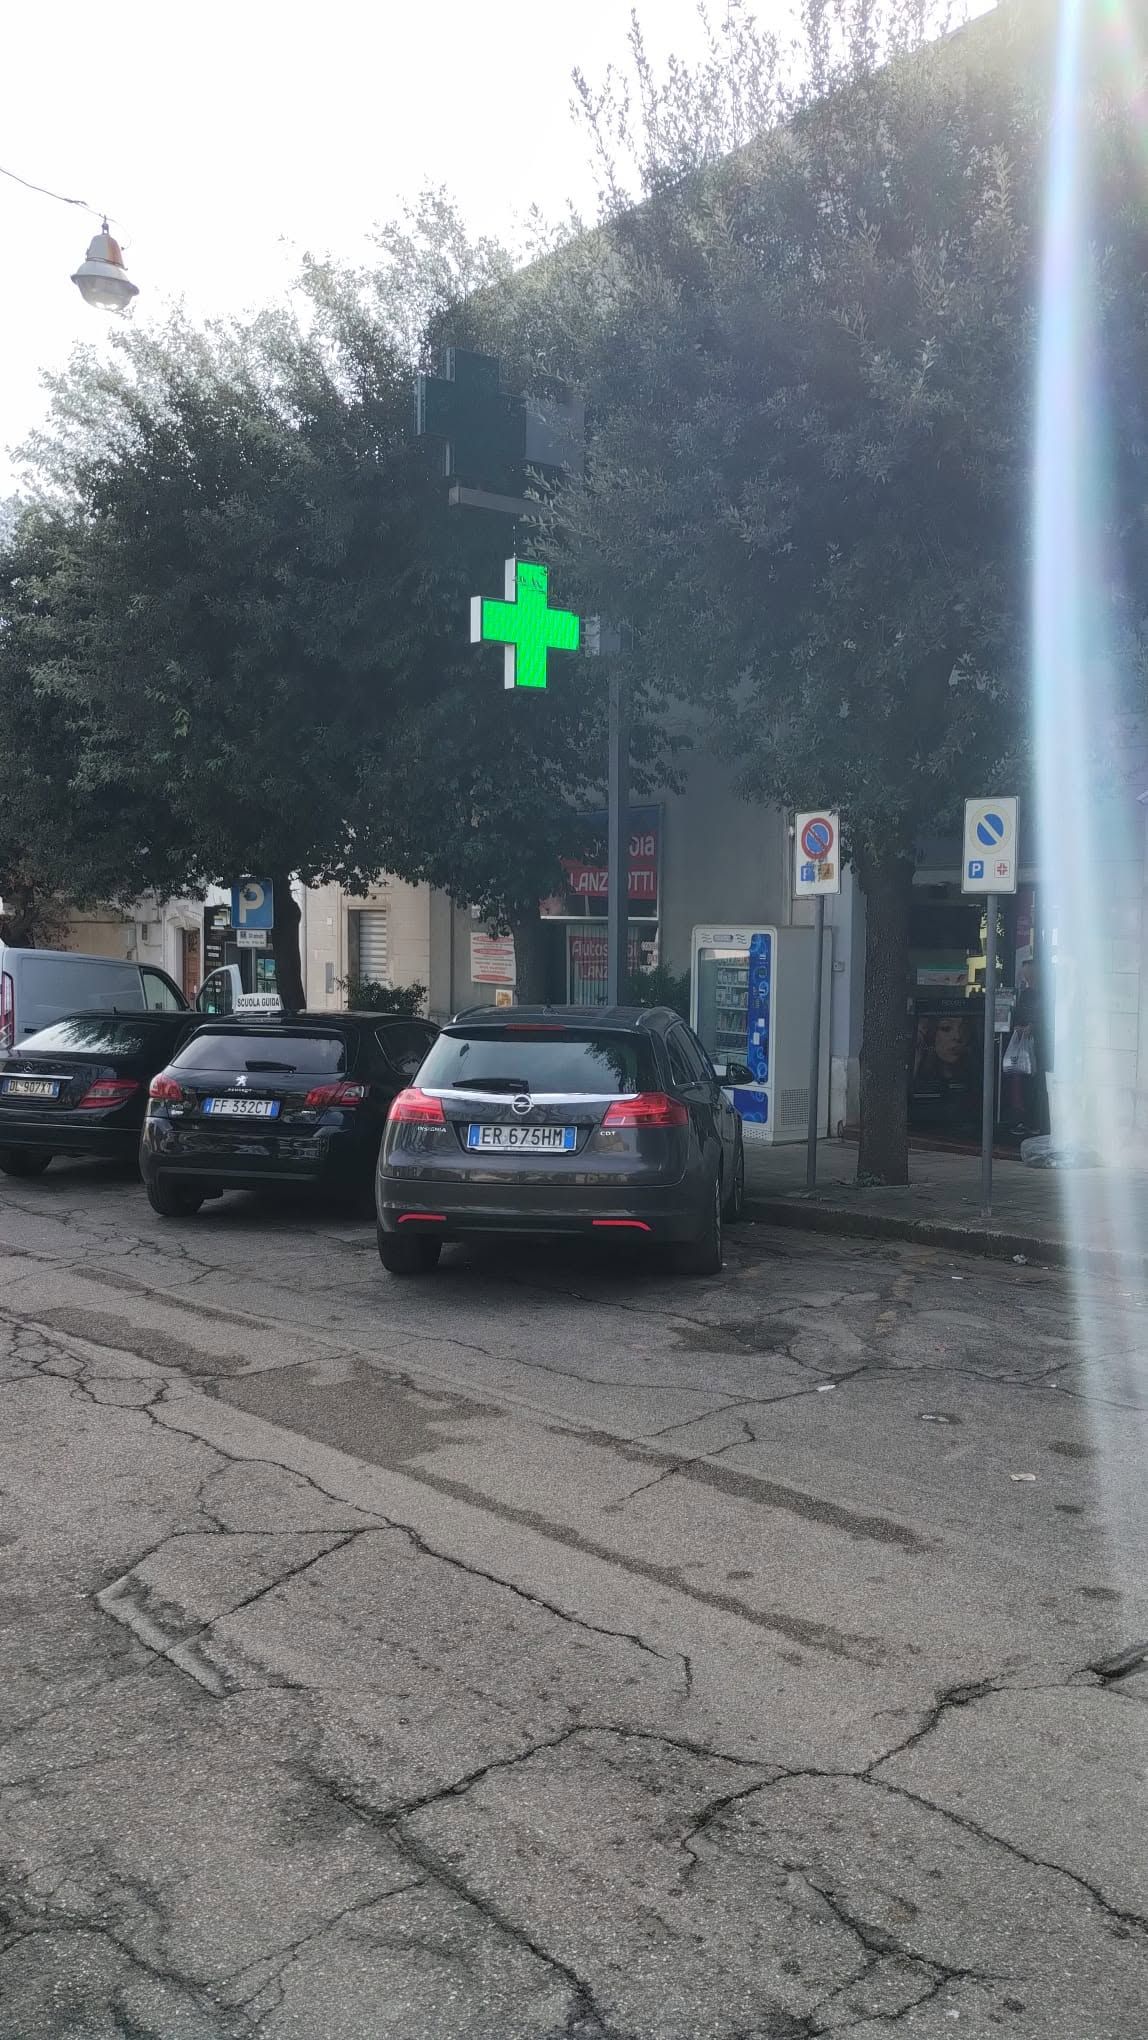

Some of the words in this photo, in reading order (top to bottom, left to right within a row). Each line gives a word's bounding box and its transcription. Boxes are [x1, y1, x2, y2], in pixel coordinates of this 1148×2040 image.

[972, 863, 982, 877] P
[239, 883, 265, 923] P
[237, 998, 260, 1007] SCUOLA
[261, 997, 280, 1006] GUIDA
[10, 1081, 20, 1091] DL
[24, 1081, 52, 1094] 907XT
[213, 1100, 229, 1112] FF
[232, 1101, 271, 1115] 332CT
[481, 1127, 503, 1144] ER
[508, 1127, 563, 1146] 675HM
